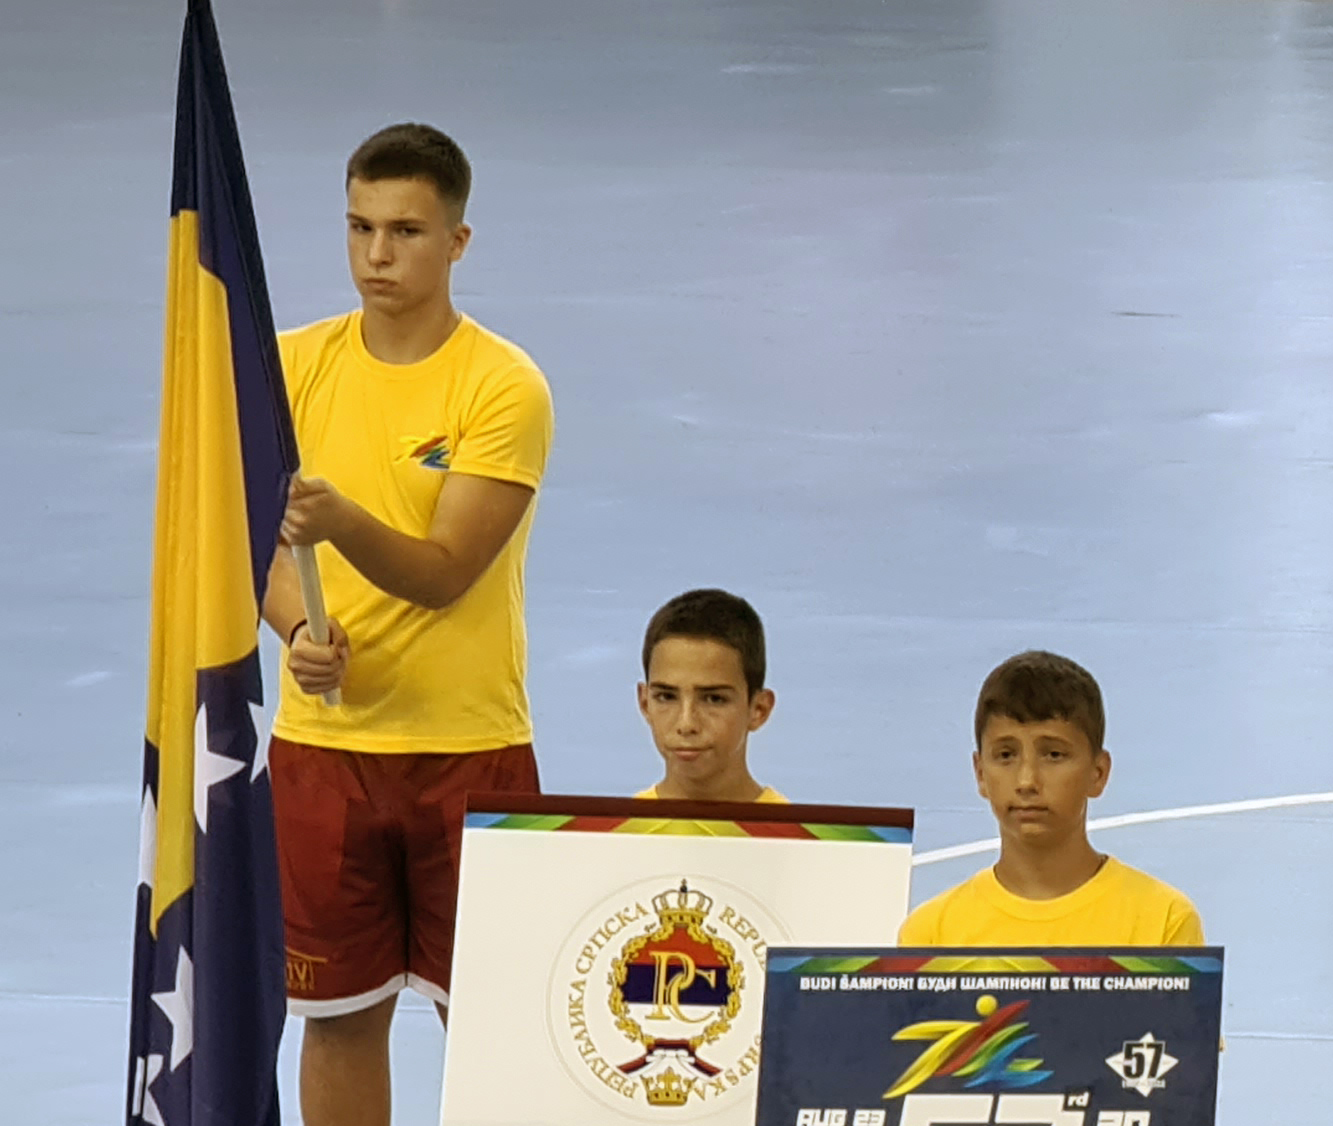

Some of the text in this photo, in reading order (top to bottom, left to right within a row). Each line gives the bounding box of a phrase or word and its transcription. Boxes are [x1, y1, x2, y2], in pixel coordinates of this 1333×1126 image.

[800, 977, 835, 990] BUDI
[1050, 977, 1190, 990] BE THE CHAMPION!
[1123, 1043, 1164, 1079] 57
